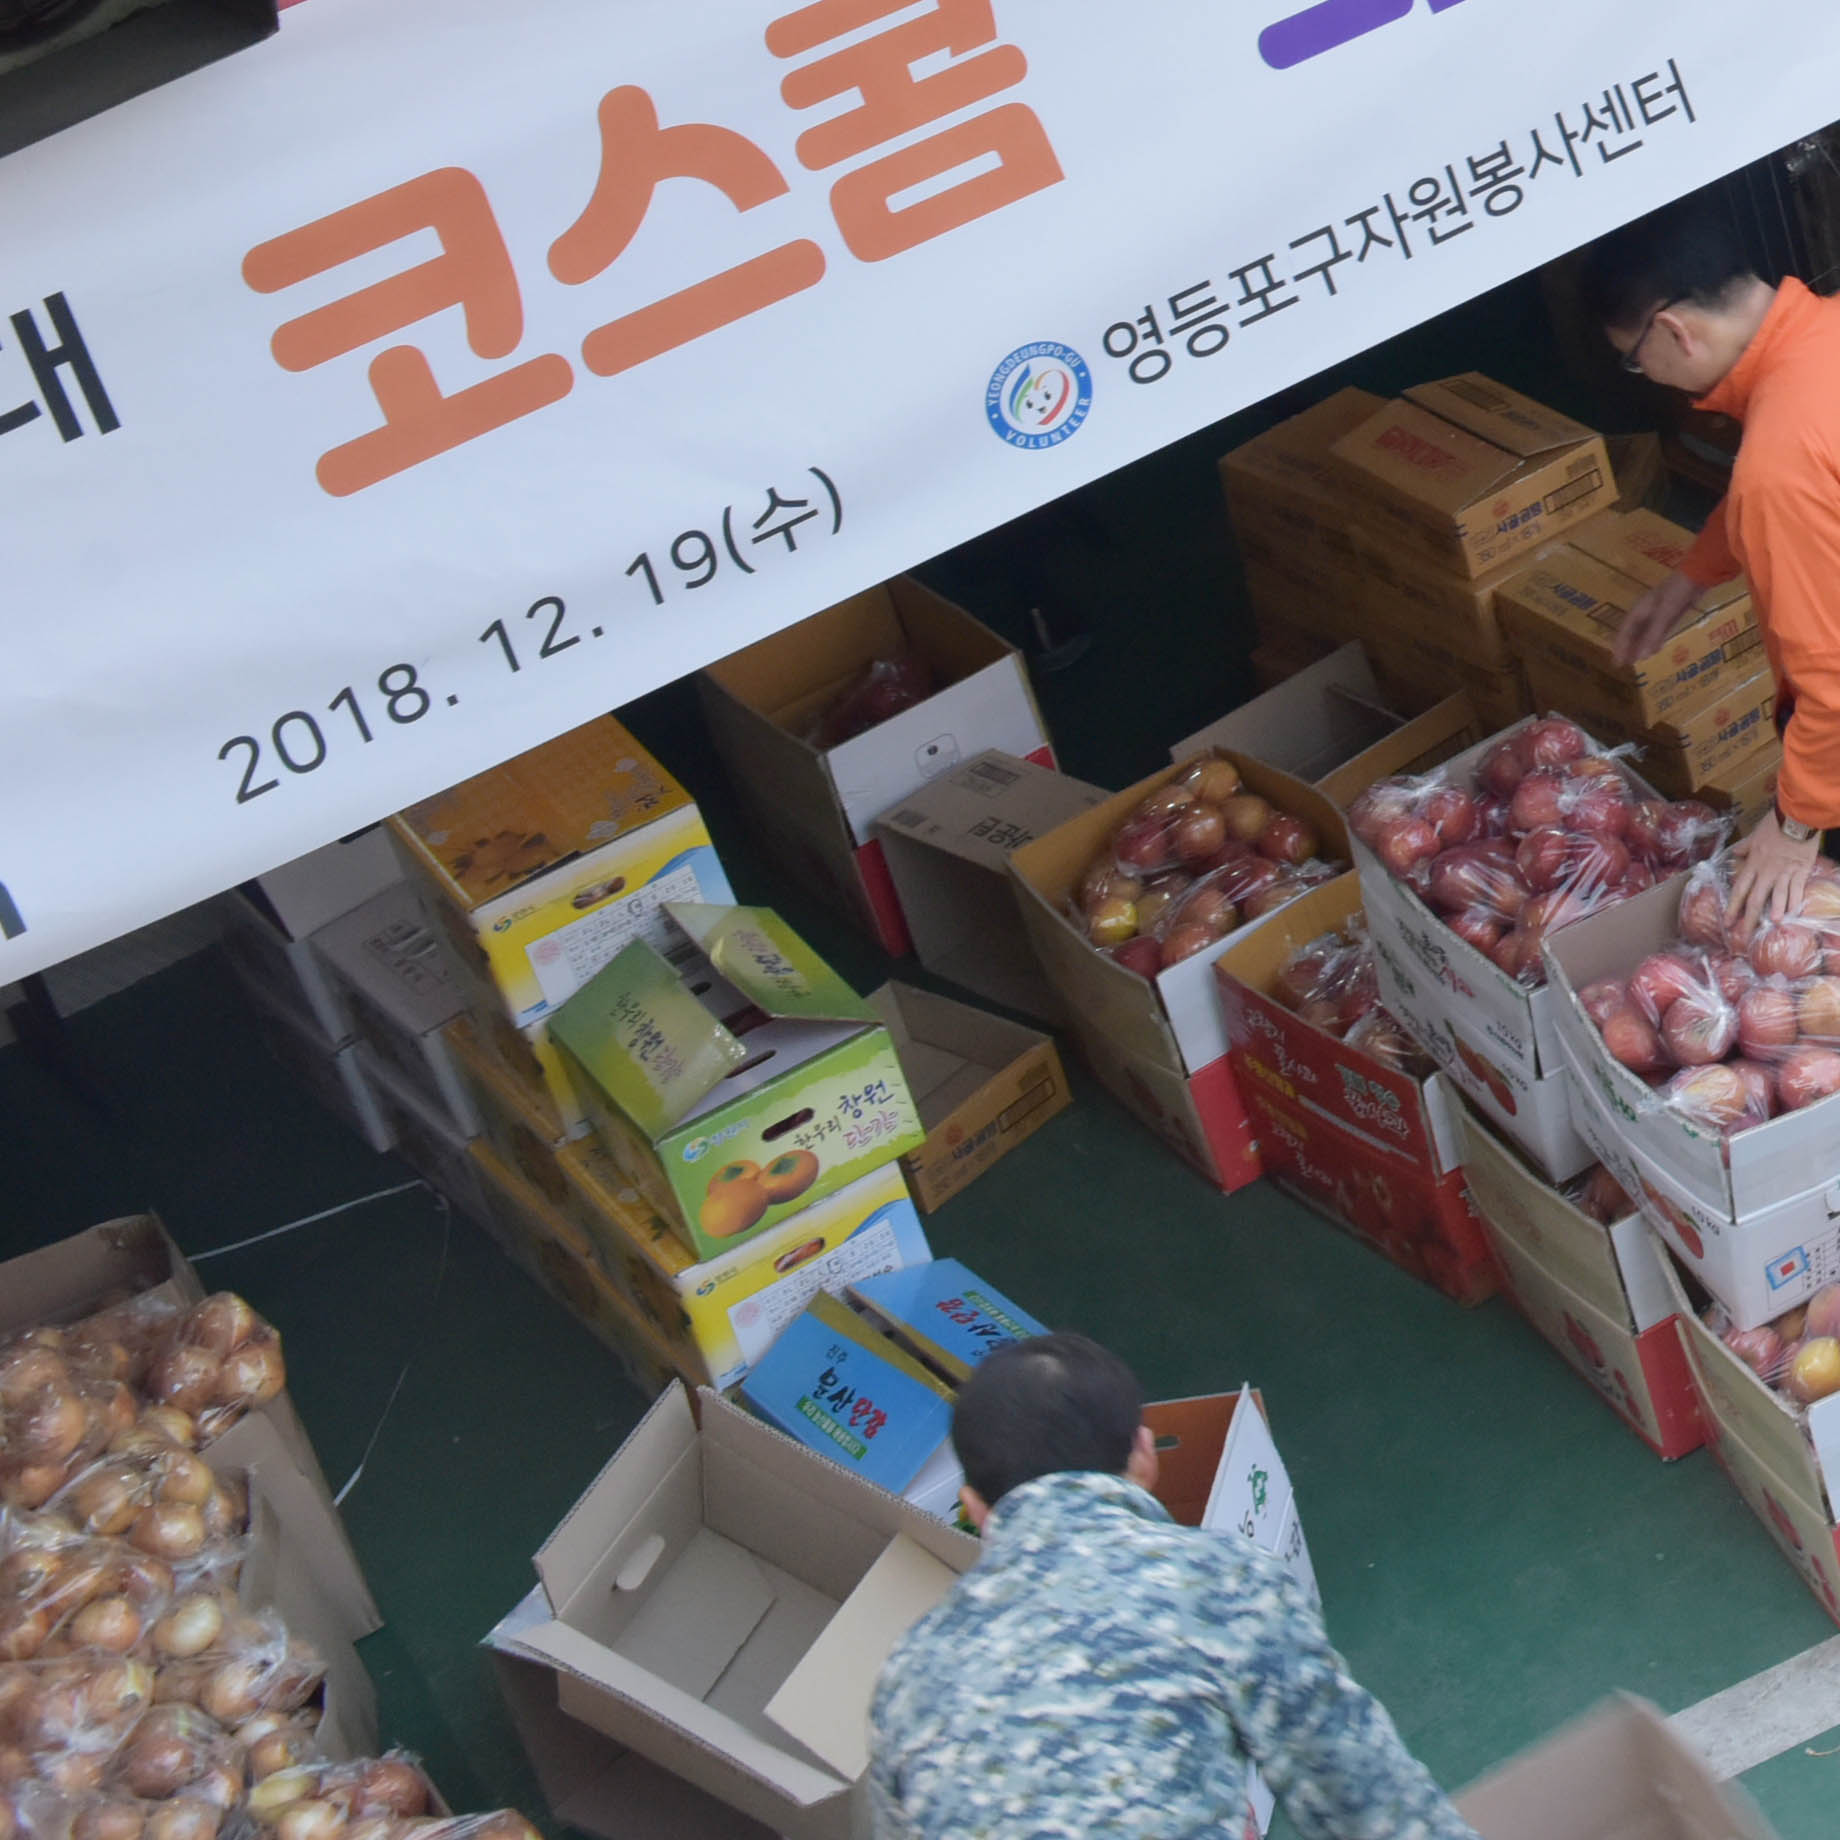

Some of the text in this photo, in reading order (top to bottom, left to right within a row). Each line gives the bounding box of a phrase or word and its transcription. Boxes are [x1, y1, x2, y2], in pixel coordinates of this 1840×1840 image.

[1101, 57, 1698, 386] 영등포구자원봉사센터
[1004, 397, 1091, 447] VOLUNTEER
[216, 465, 845, 805] 2018. 12. 19(수)
[838, 1080, 895, 1118] 창원
[793, 1116, 842, 1150] 한우리
